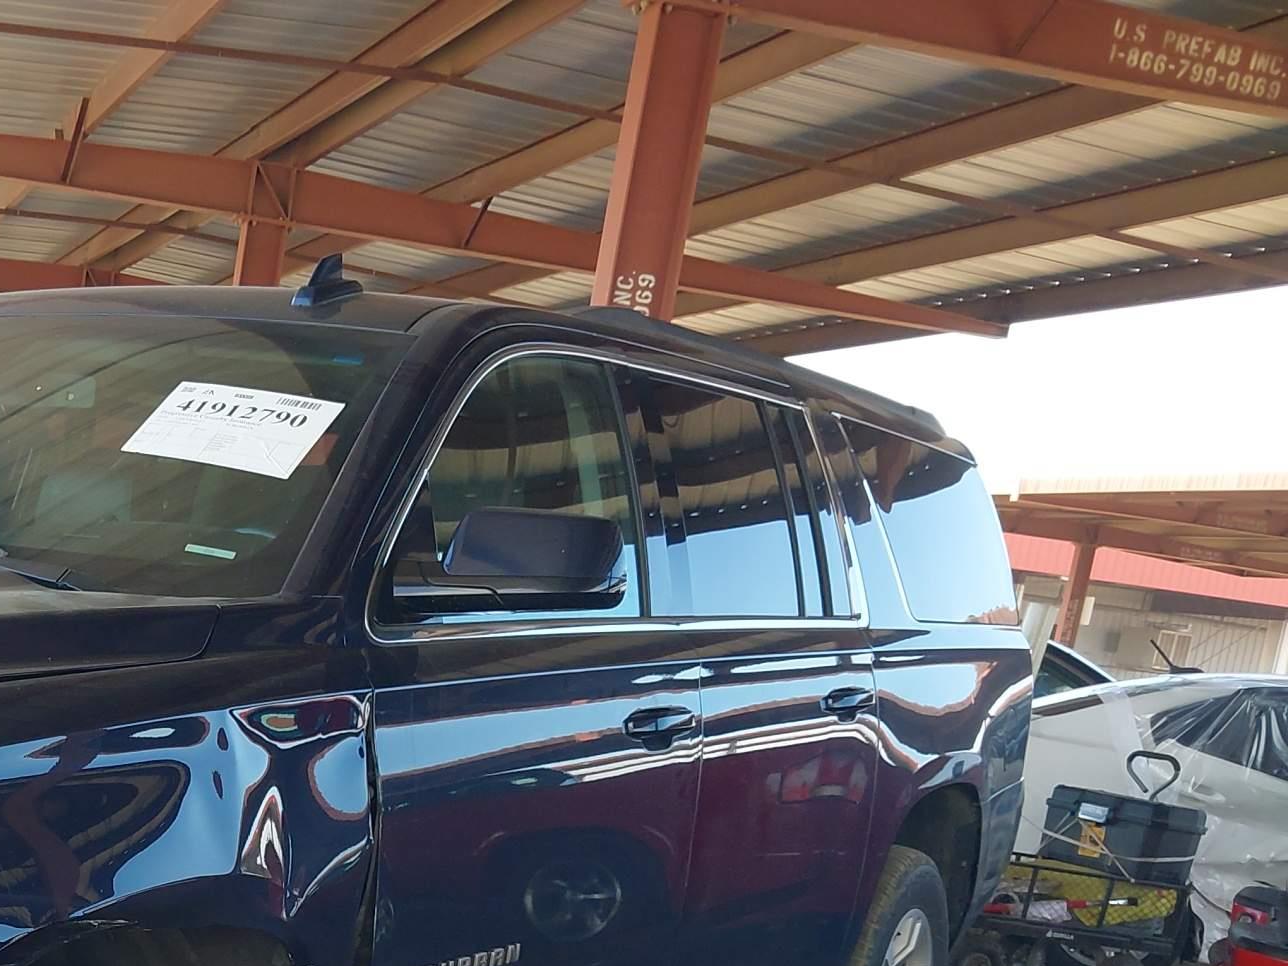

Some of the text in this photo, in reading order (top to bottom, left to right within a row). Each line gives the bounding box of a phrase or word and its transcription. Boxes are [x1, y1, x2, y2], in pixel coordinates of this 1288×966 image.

[1108, 43, 1281, 101] 1-866-799-0969
[1162, 29, 1243, 67] PREFAB
[1249, 50, 1287, 79] INC.
[176, 398, 309, 429] 41912790
